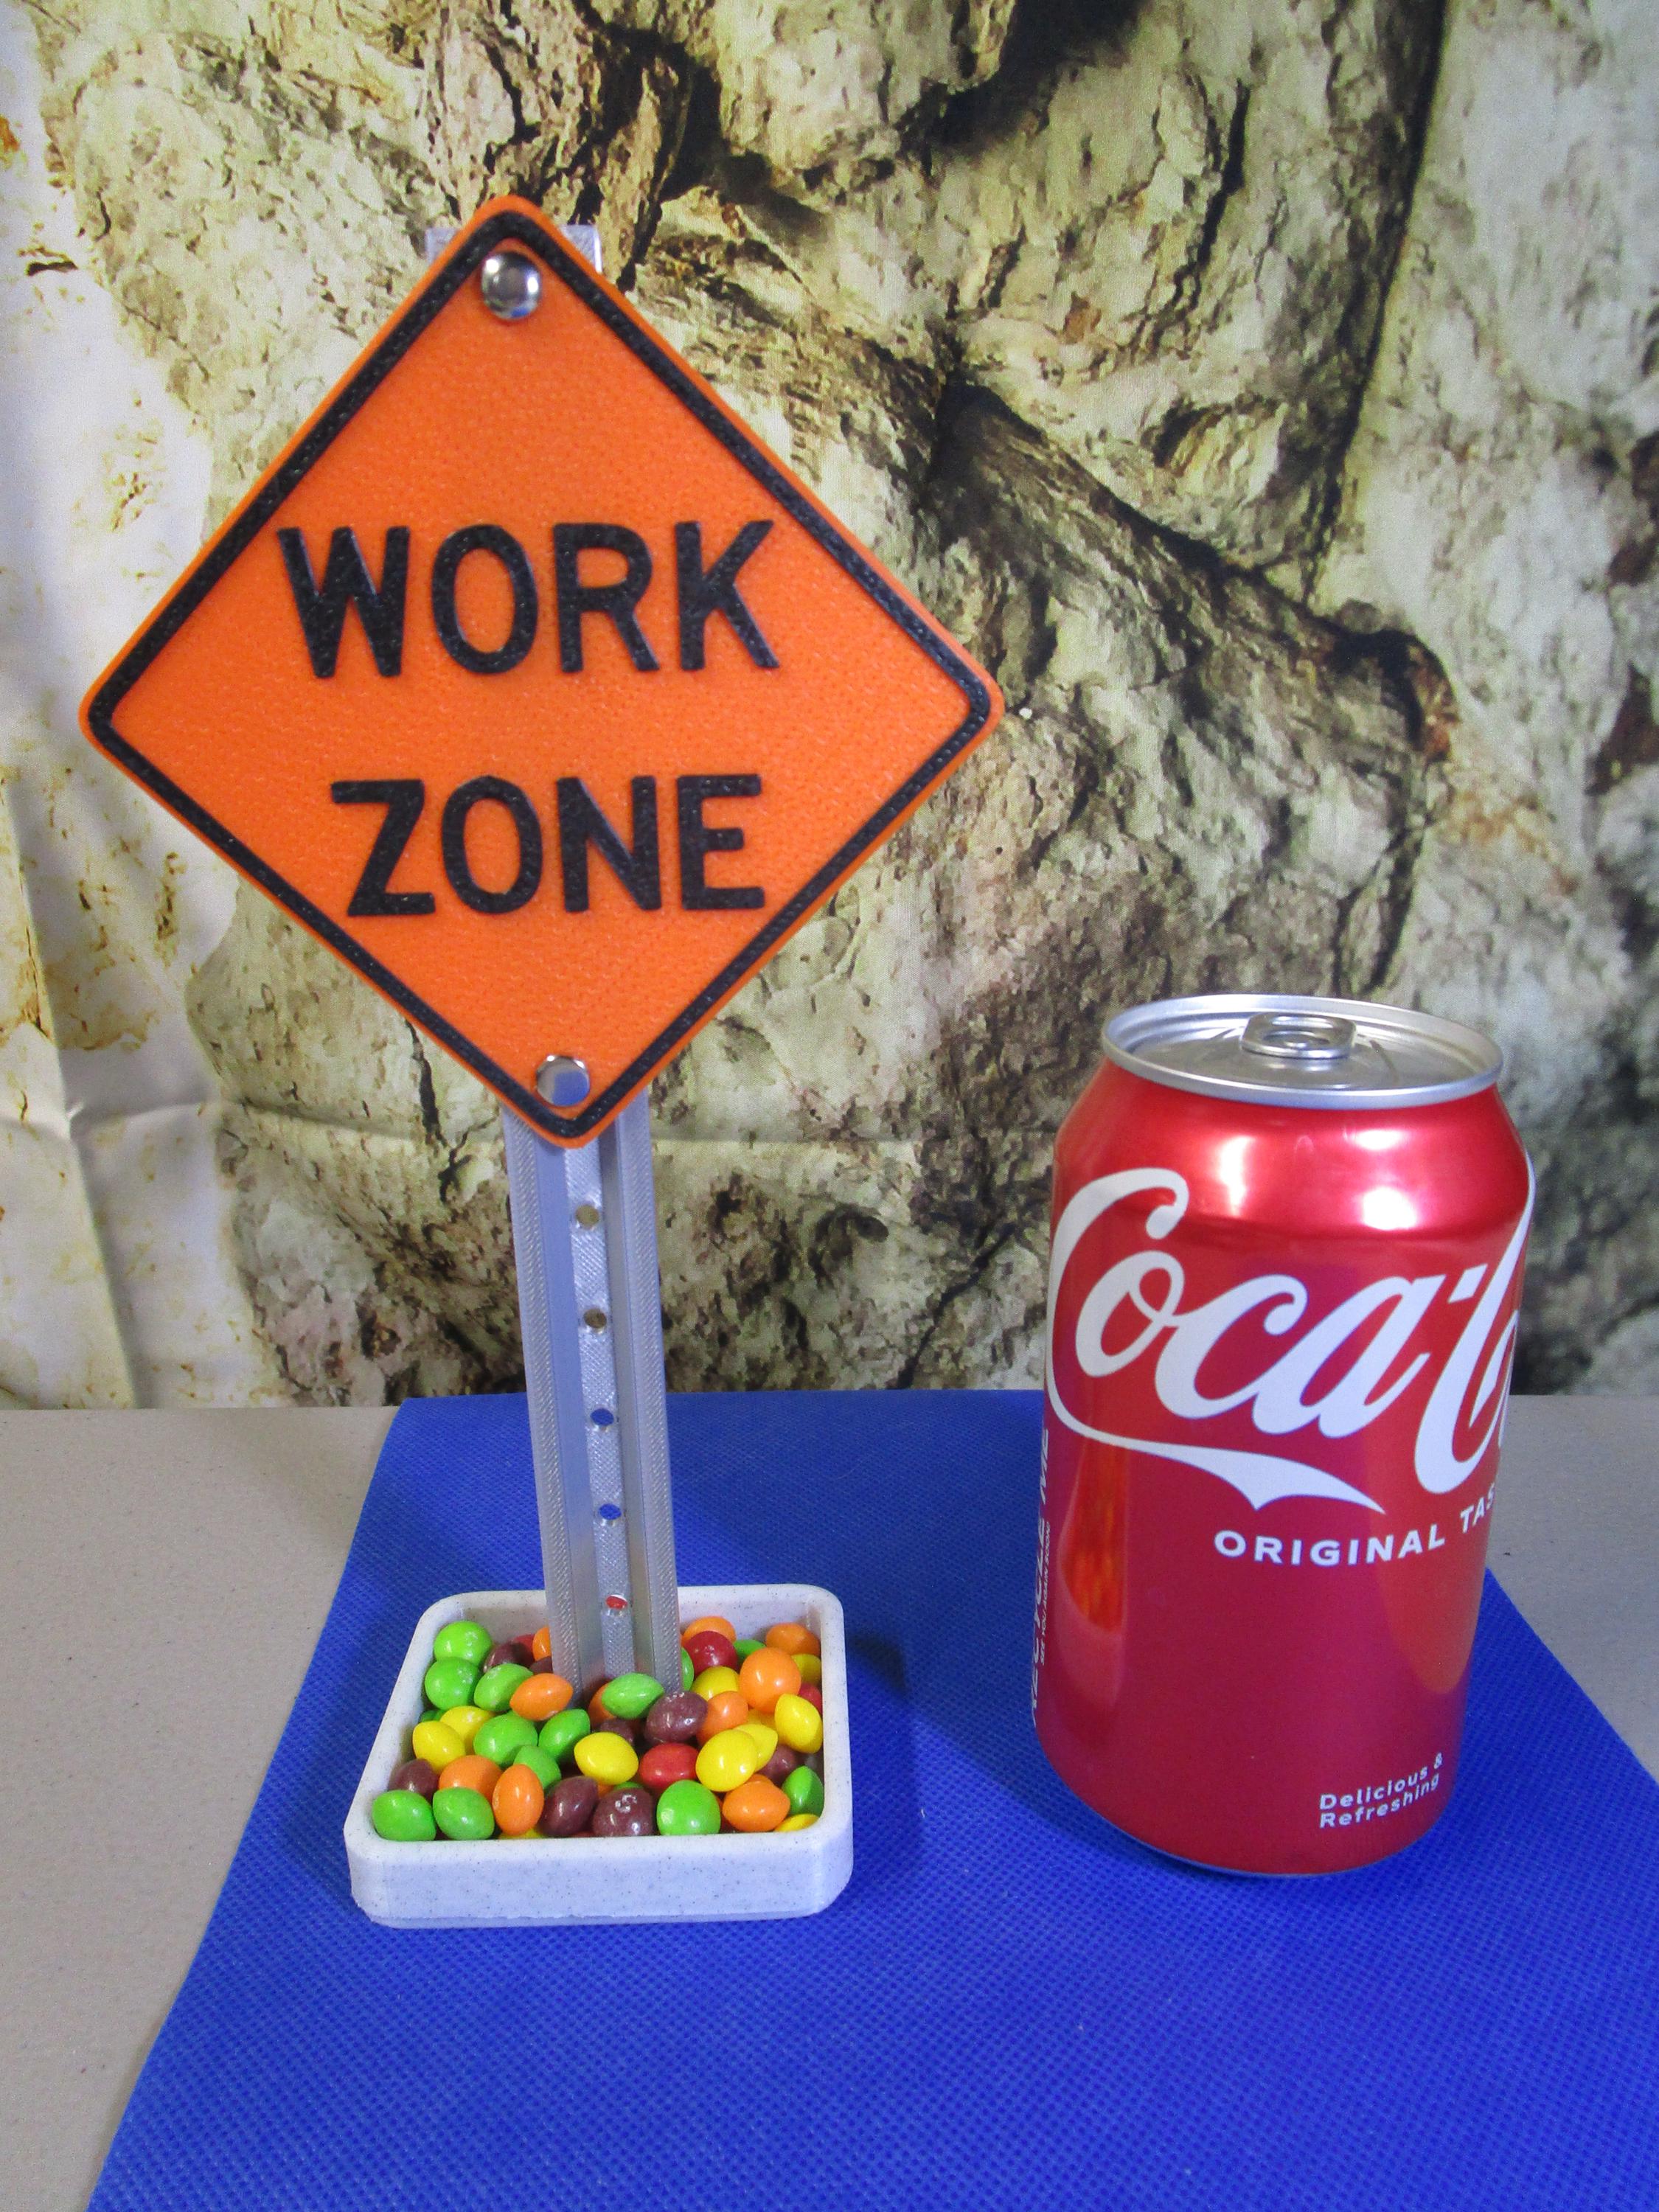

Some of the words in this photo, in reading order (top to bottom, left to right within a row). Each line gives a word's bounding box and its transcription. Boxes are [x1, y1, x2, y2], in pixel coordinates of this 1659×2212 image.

[276, 519, 780, 678] WORK
[330, 774, 766, 917] ZONE
[1214, 1522, 1445, 1568] ORIGINAL
[1319, 1764, 1428, 1811] Delicious
[1433, 1752, 1444, 1770] &
[1319, 1773, 1440, 1828] Refreshing
